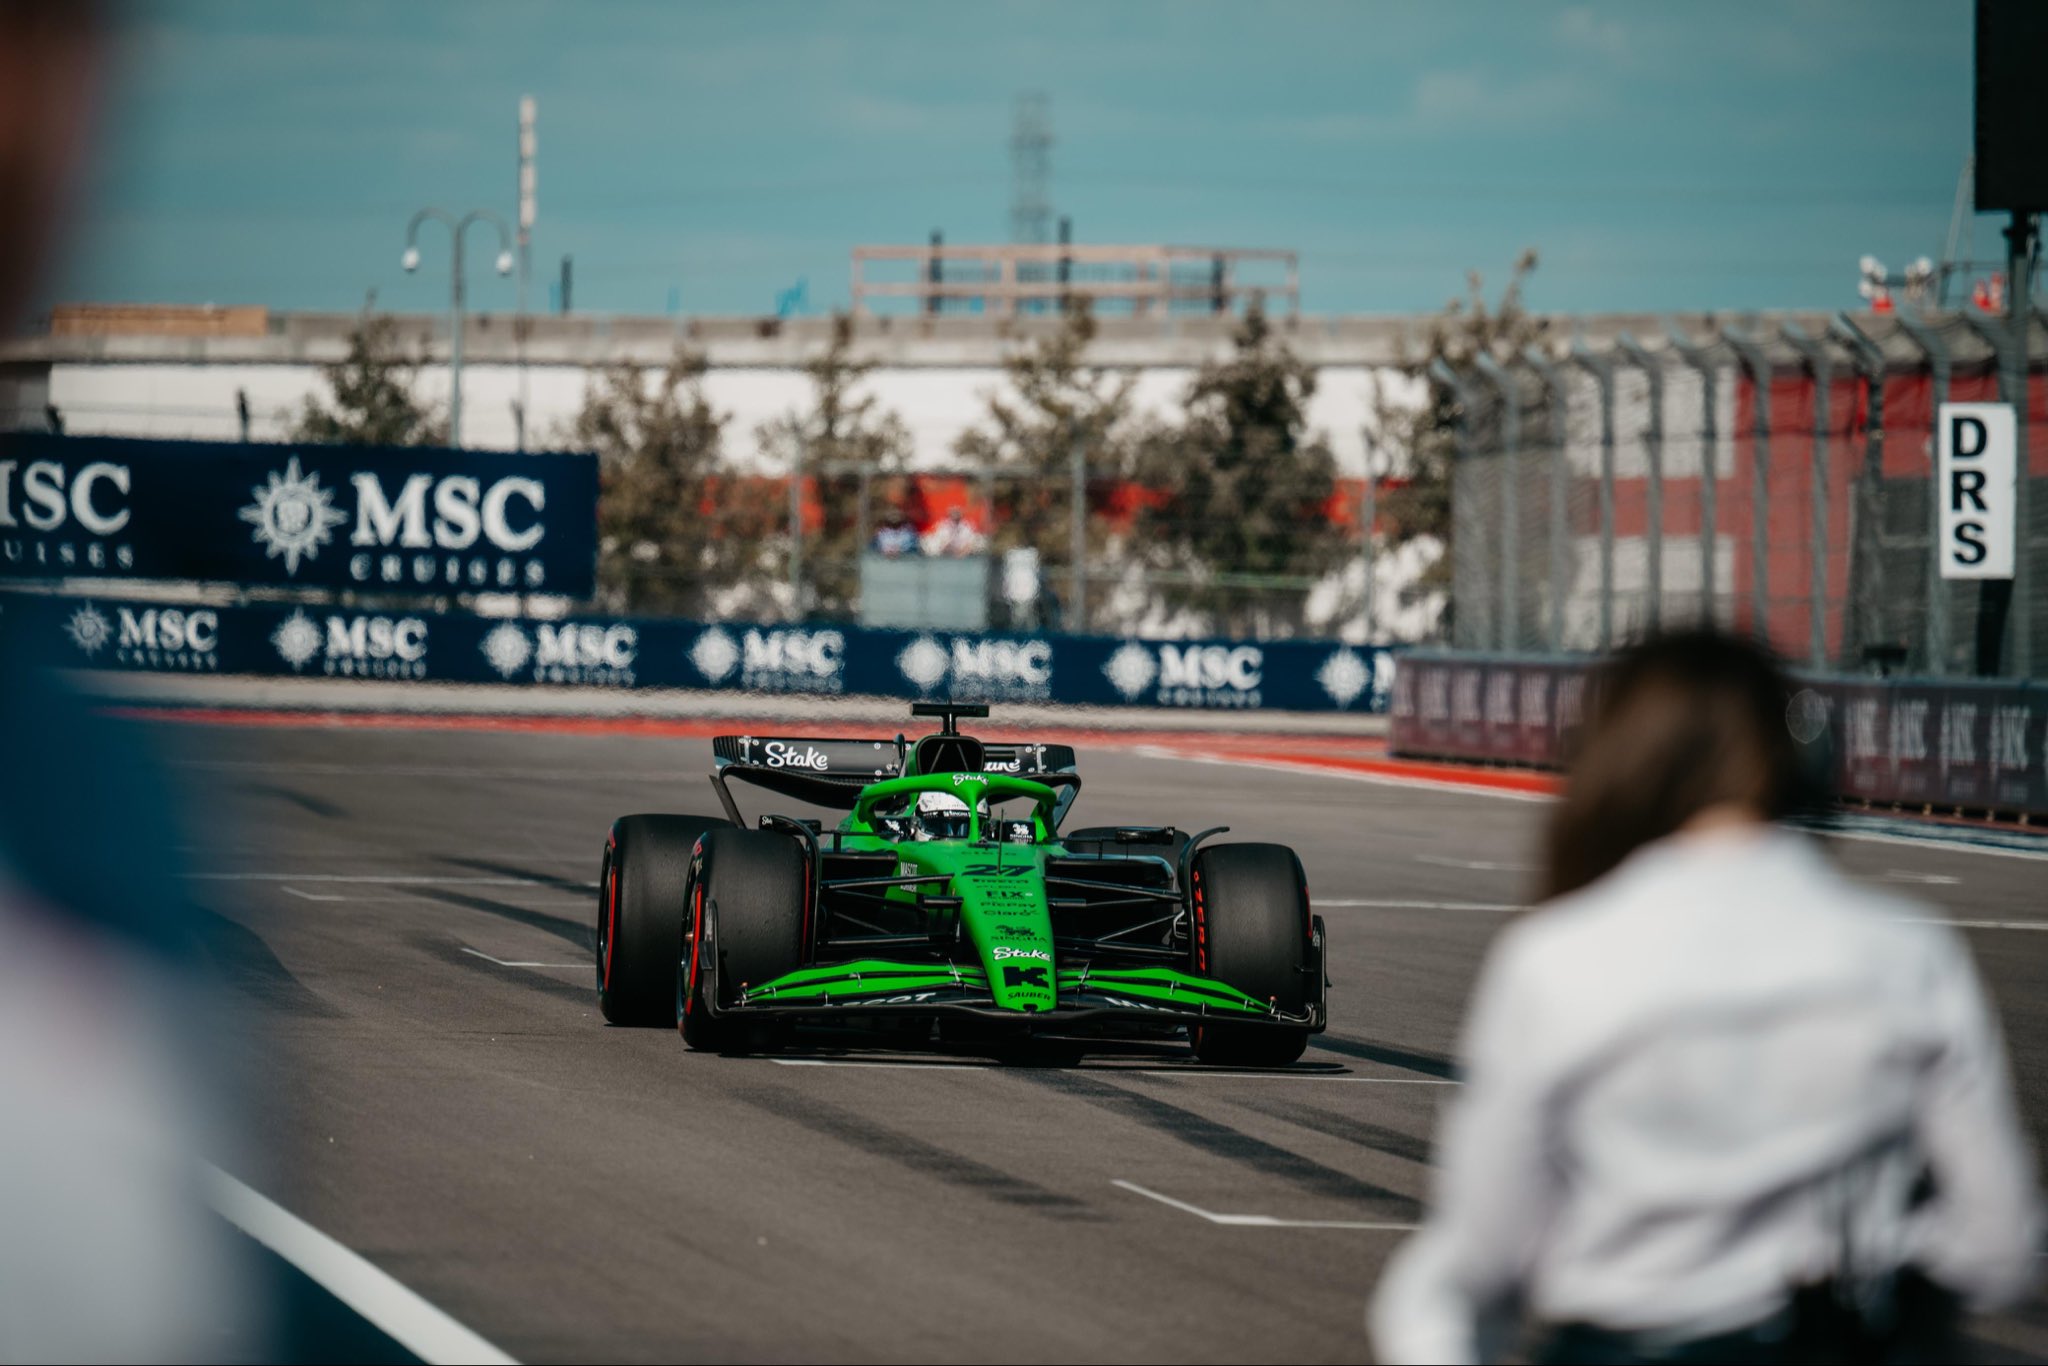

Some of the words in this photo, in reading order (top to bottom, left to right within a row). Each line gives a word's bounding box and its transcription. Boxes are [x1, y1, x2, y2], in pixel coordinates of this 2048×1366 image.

[0, 459, 131, 535] SC
[1952, 417, 1988, 565] DRS
[350, 471, 546, 552] MSC
[117, 607, 218, 652] MSC
[326, 615, 428, 661] MSC
[537, 623, 638, 669] MSC
[1159, 644, 1263, 690] MSC
[765, 742, 829, 771] Stake
[953, 774, 989, 786] Stake
[961, 864, 1036, 877] 27
[986, 890, 1023, 898] FIX
[992, 946, 1051, 962] Stake
[1003, 965, 1050, 989] K
[1007, 991, 1052, 1001] SAUBER
